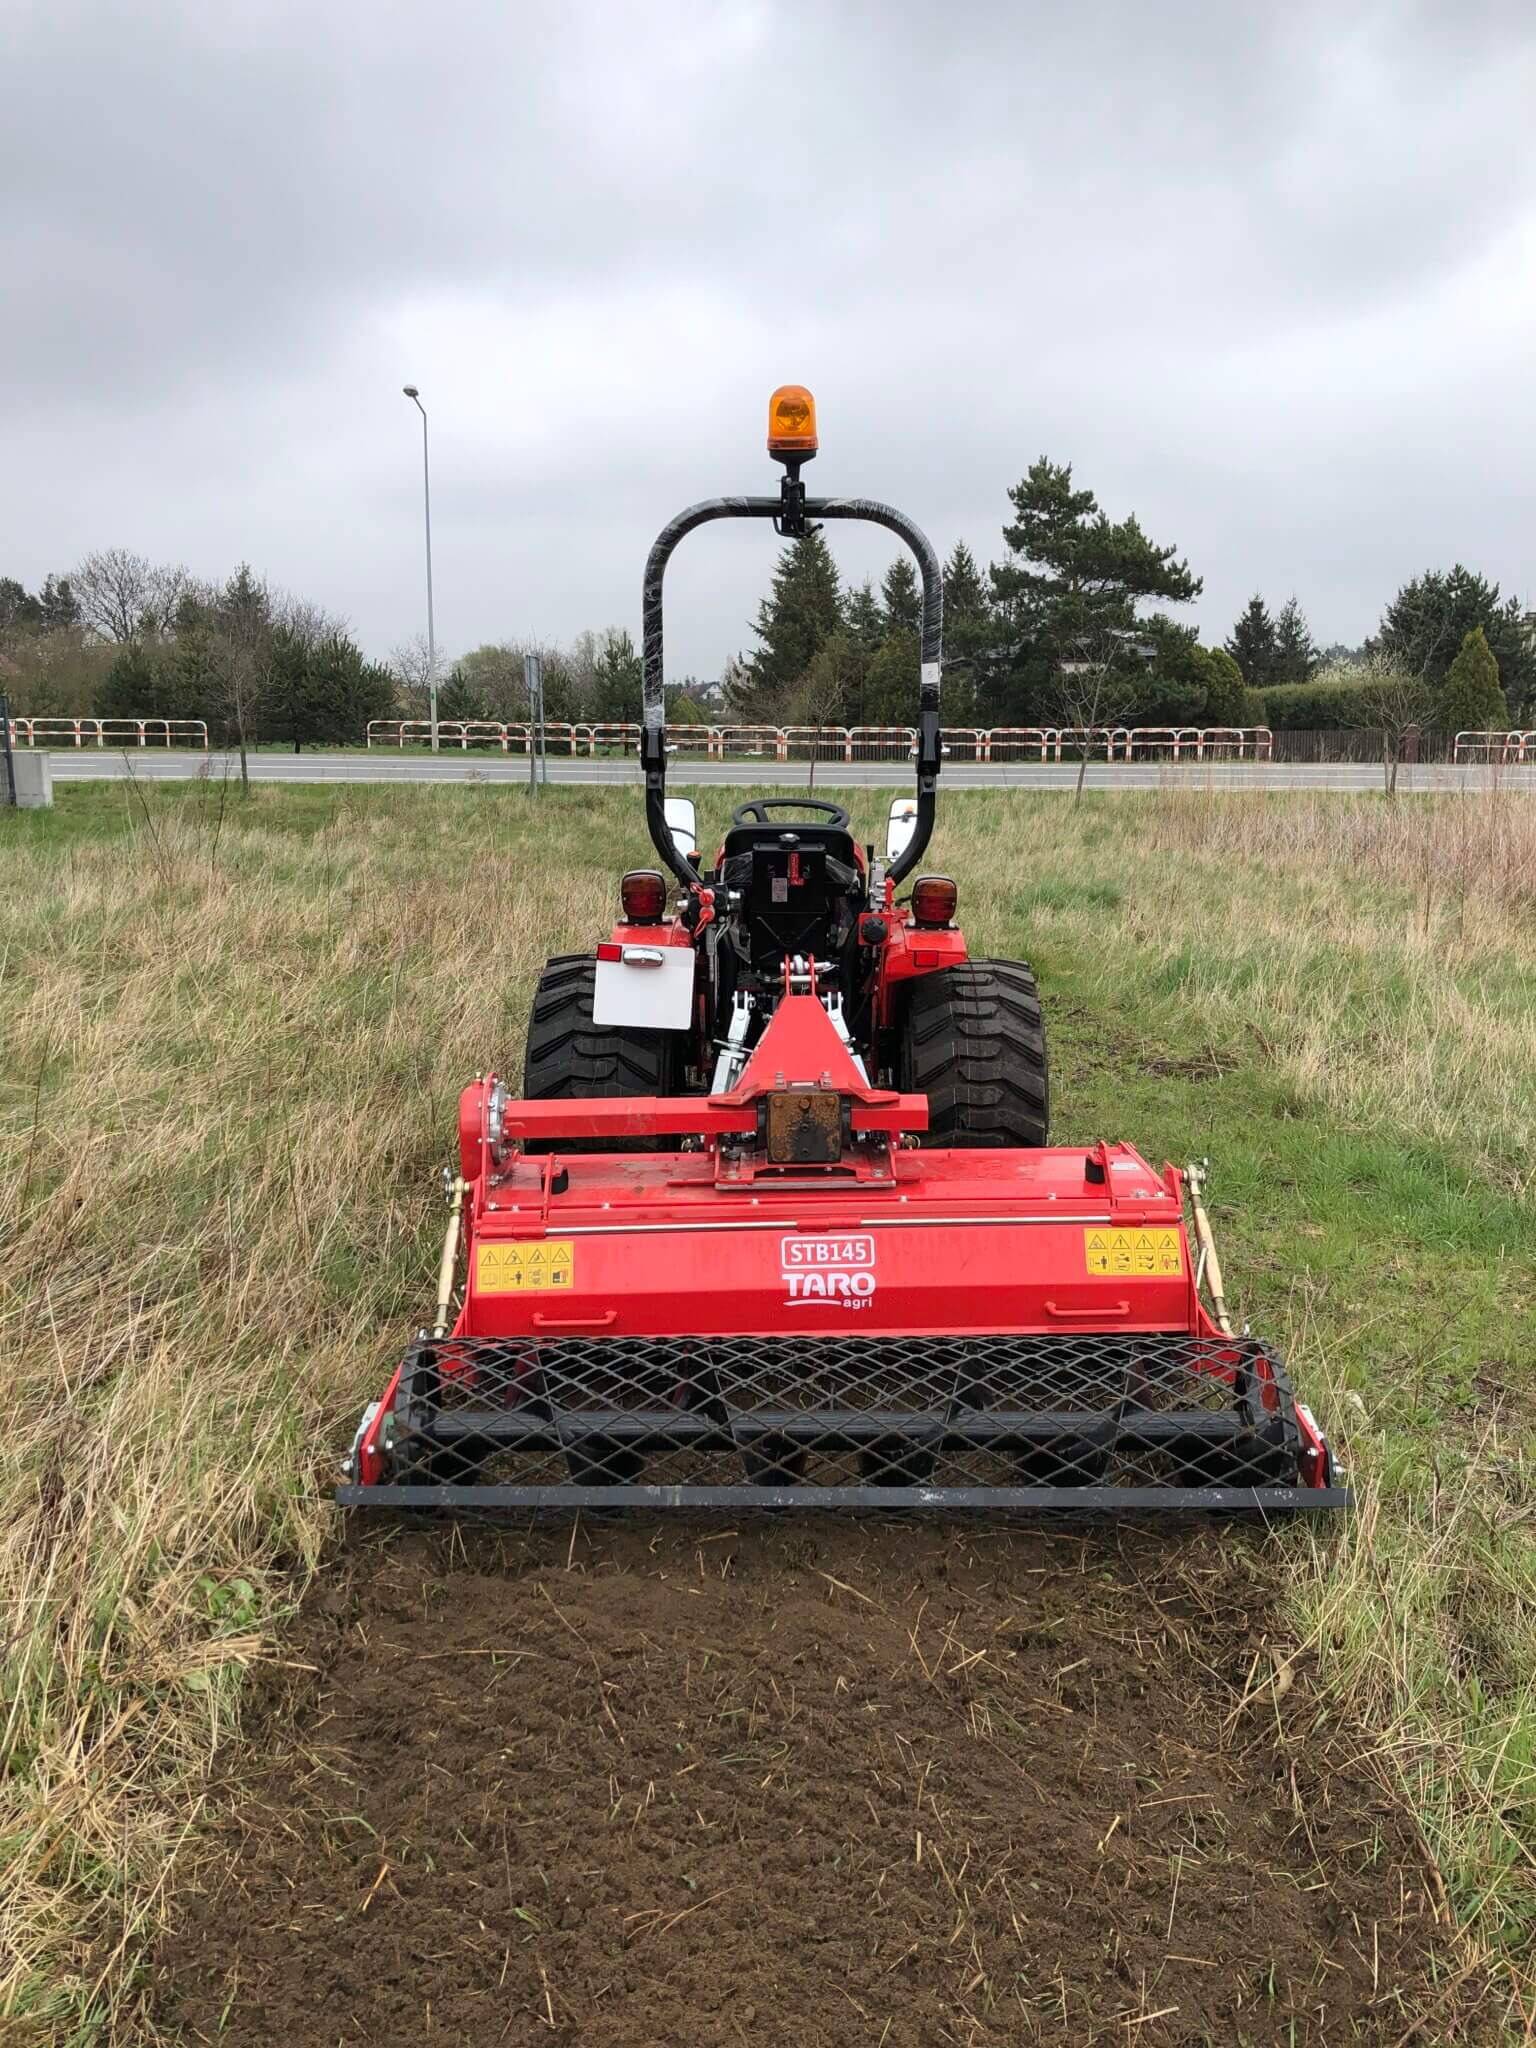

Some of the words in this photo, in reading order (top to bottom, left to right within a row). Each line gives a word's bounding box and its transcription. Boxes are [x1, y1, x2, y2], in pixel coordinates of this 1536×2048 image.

[791, 1243, 866, 1262] STB145
[782, 1272, 875, 1297] TARO
[843, 1297, 872, 1309] agri
